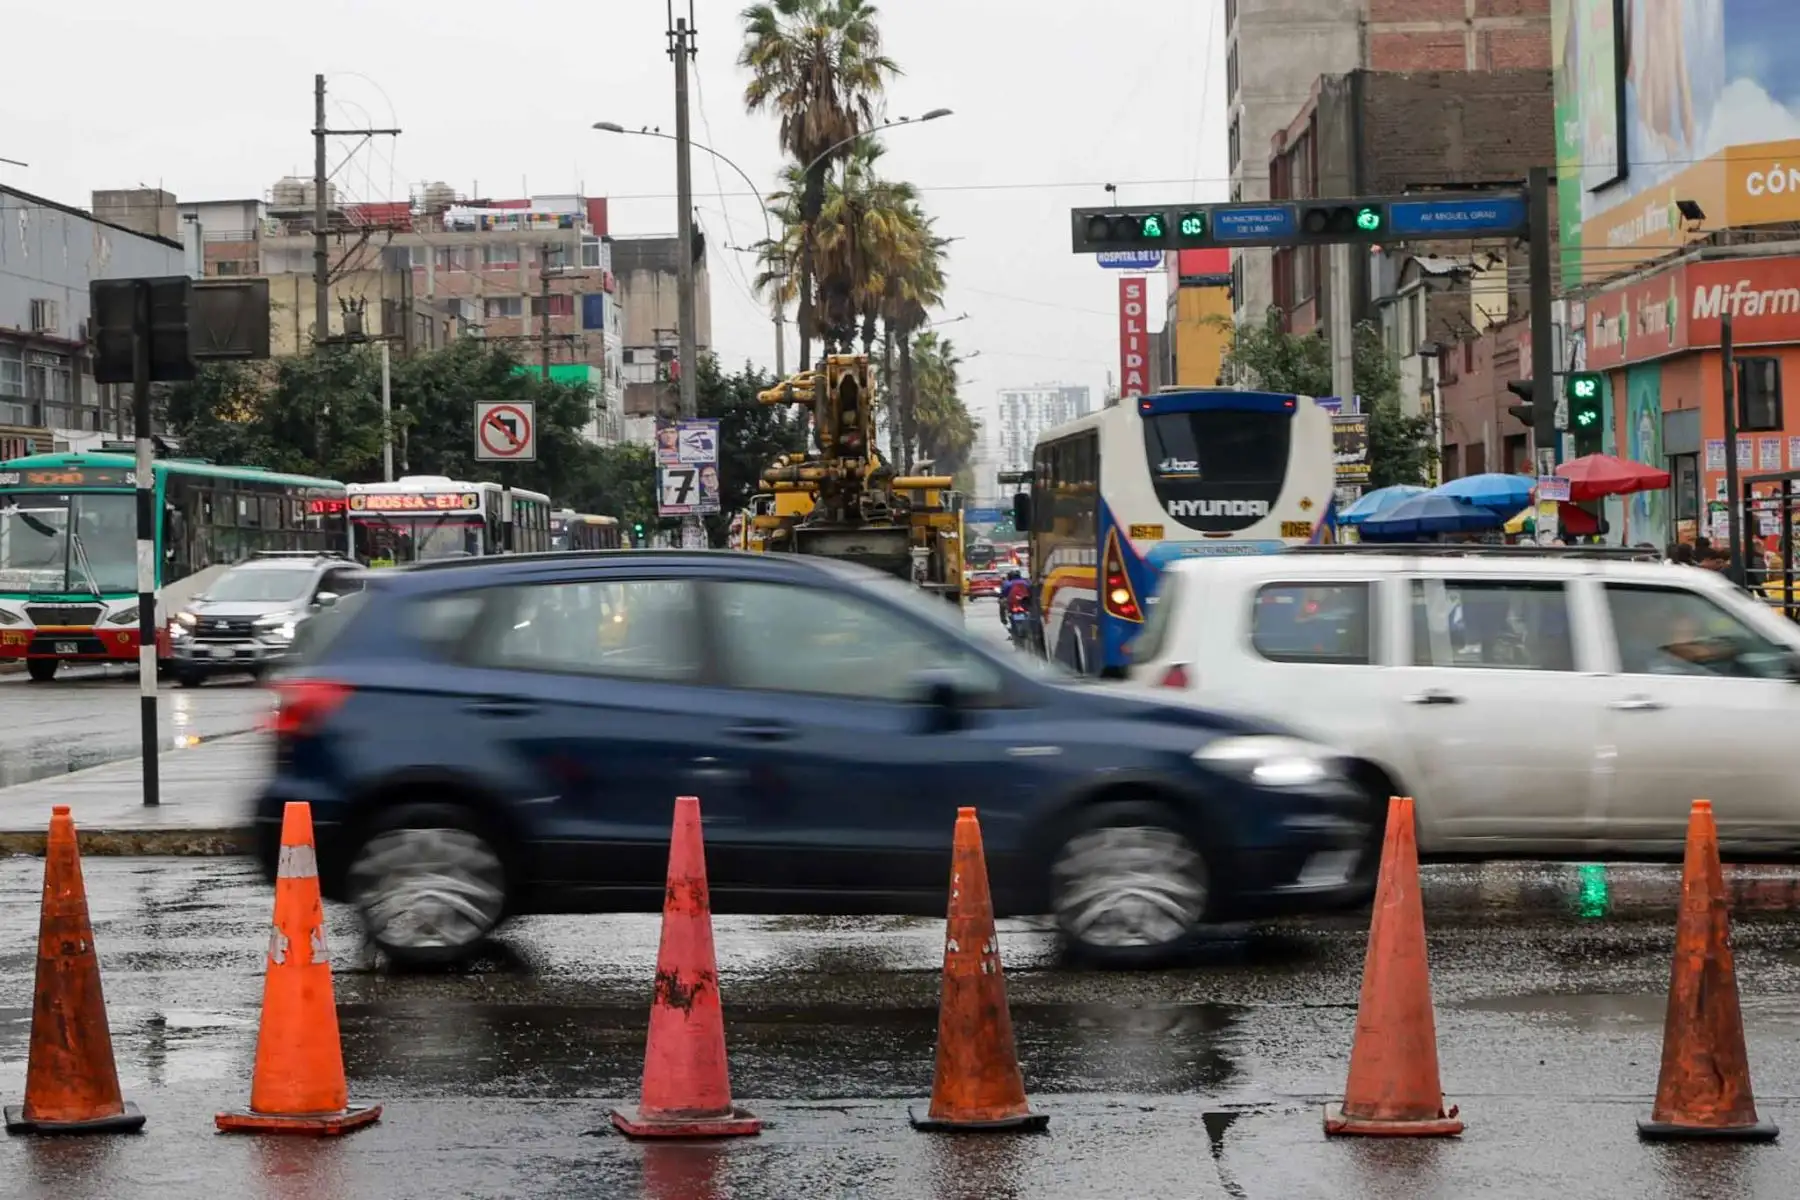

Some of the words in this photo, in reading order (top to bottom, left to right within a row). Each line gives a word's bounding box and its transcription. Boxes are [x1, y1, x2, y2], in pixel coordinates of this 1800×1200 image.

[1221, 214, 1284, 224] MUNICIPALIDAD
[1435, 212, 1469, 221] MIGUEL
[1470, 210, 1497, 220] GRAU
[1237, 225, 1248, 233] DE
[1250, 224, 1270, 233] LIMA
[1099, 250, 1137, 262] HOSPITAL
[1138, 249, 1149, 261] DE
[1150, 249, 1161, 261] LA
[1575, 380, 1595, 397] 82
[669, 470, 696, 504] 7
[1168, 500, 1269, 517] HYUNDAI
